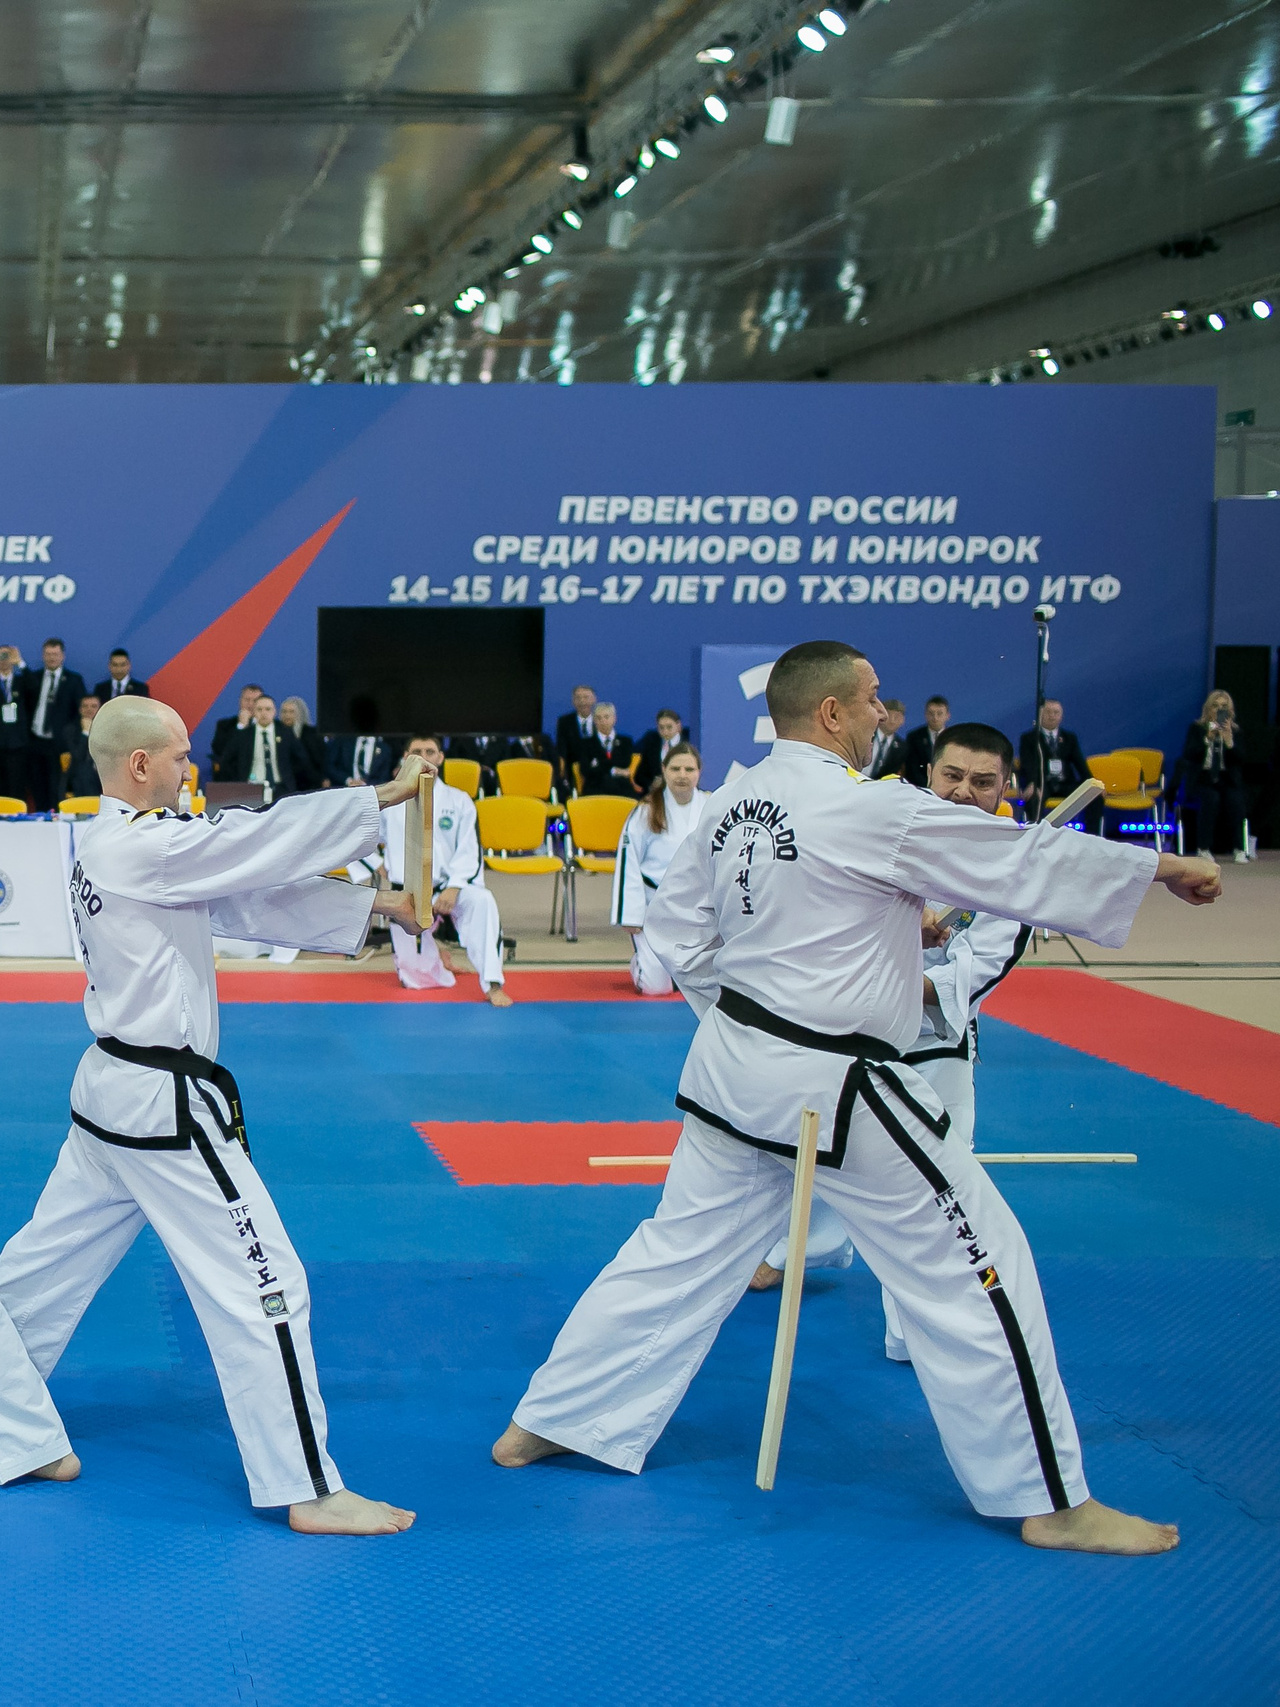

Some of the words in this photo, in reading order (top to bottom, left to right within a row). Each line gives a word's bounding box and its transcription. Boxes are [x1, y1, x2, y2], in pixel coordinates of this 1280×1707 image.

[559, 496, 798, 523] ПЕРВЕНСТВО
[809, 496, 958, 523] РОССИИ
[473, 535, 599, 569] СРЕДИ
[608, 535, 802, 563] ЮНИОРОВ
[811, 536, 838, 563] И
[848, 536, 1040, 563] ЮНИОРОК
[502, 575, 529, 602] И
[651, 575, 725, 602] ЛЕТ
[733, 575, 787, 602] ПО
[799, 575, 1029, 608] ТХЭКВОНДО
[1040, 574, 1121, 603] ИТФ
[710, 798, 799, 862] TAEKWON-DO
[742, 825, 760, 838] ITF
[934, 1186, 955, 1207] ITF
[228, 1204, 249, 1219] ITF
